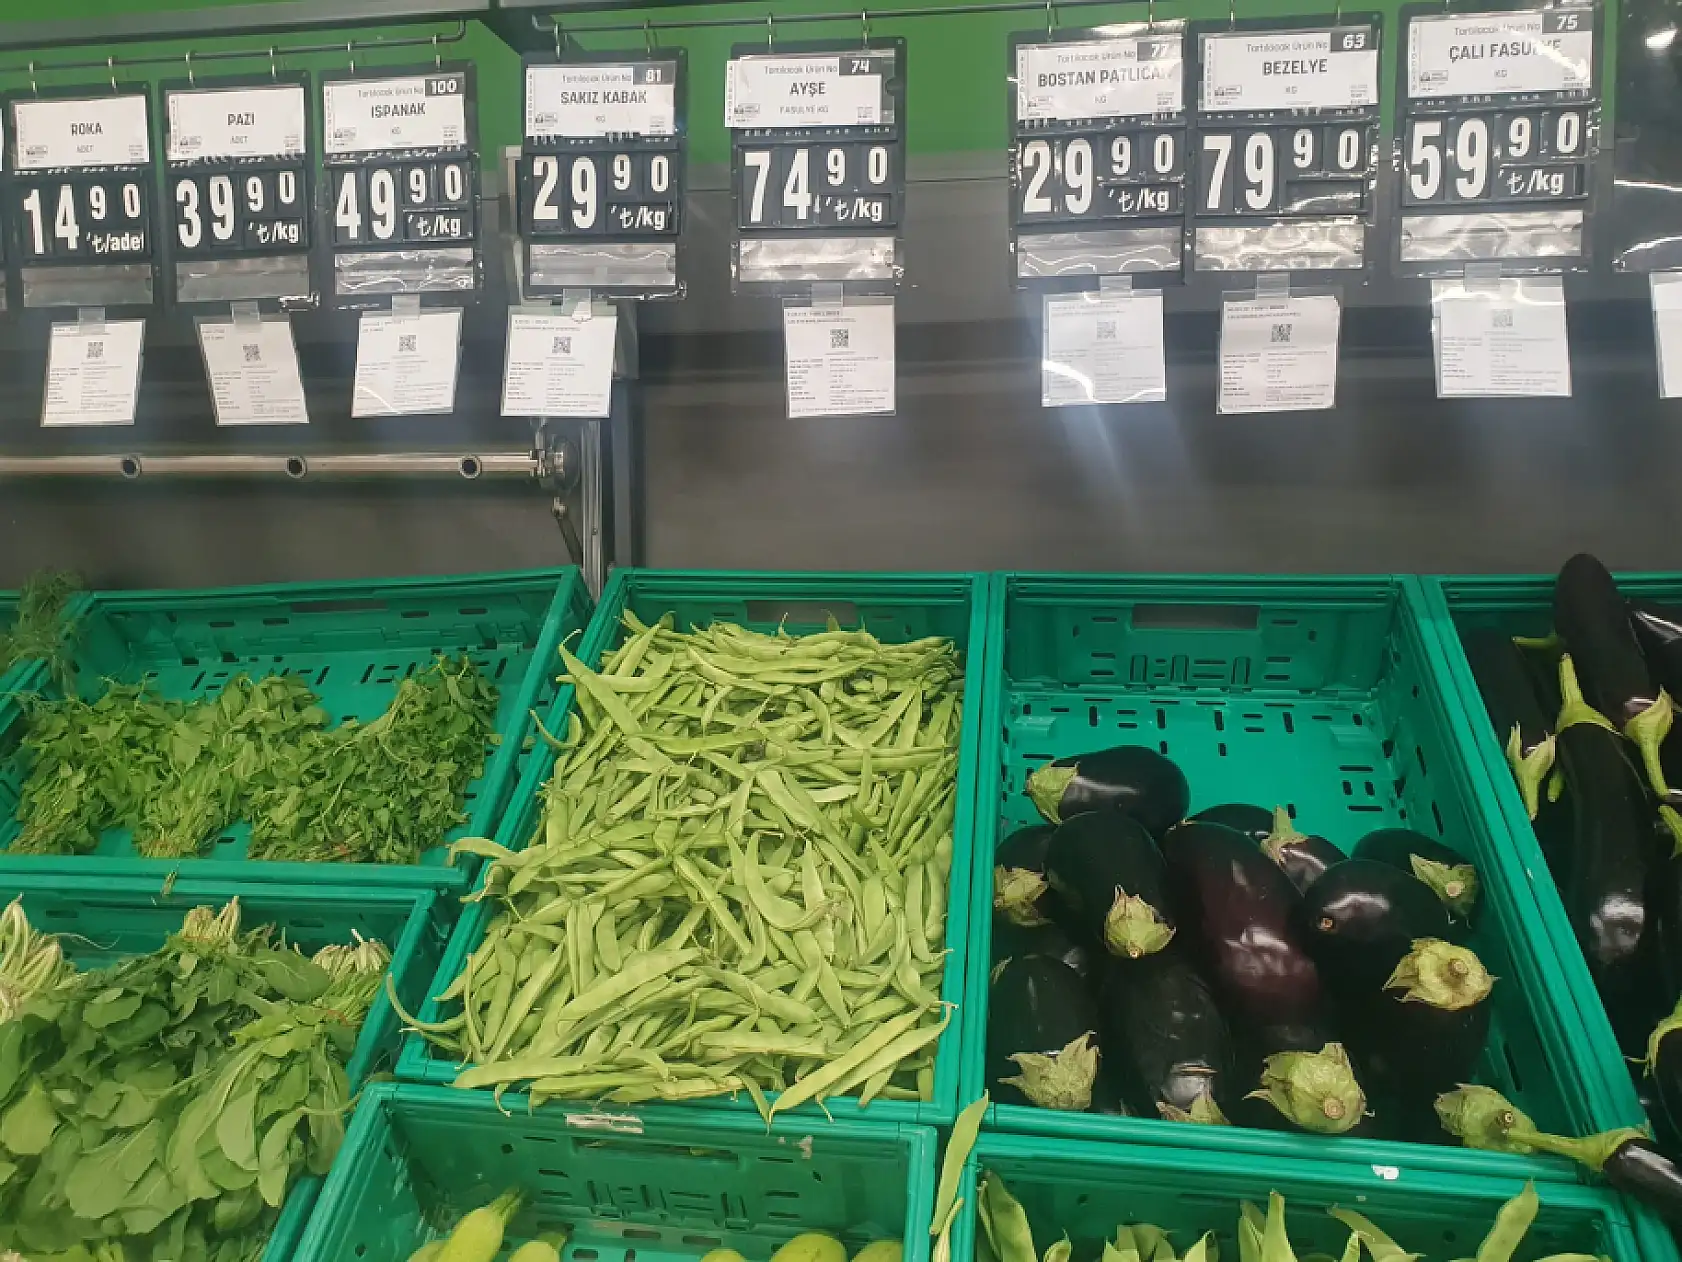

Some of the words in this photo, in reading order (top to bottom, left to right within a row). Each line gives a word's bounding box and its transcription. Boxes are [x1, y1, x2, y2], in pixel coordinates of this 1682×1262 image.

[1556, 14, 1579, 30] 75
[1448, 44, 1485, 64] ÇALI
[1490, 39, 1562, 58] FASUE
[851, 58, 870, 74] 74
[1263, 58, 1328, 76] BEZELYE
[430, 79, 457, 95] 100
[1038, 69, 1096, 87] BOSTAN
[560, 90, 599, 105] SAKIZ
[603, 90, 648, 104] KABAK
[789, 81, 827, 97] AYŞE
[371, 101, 426, 118] ISPANAK
[71, 122, 103, 137] ROKA
[1411, 118, 1487, 199] 59
[1509, 112, 1579, 157] 90
[1023, 138, 1093, 214] 29
[1112, 134, 1174, 175] 90
[1204, 132, 1273, 210] 79
[1294, 129, 1358, 169] 90
[534, 156, 596, 228] 29
[613, 155, 668, 192] 90
[745, 149, 812, 223] 74
[828, 147, 887, 186] 90
[177, 176, 234, 247] 39
[247, 171, 295, 212] 90
[337, 169, 394, 239] 49
[410, 165, 462, 203] 90
[24, 184, 79, 254] 14
[90, 184, 140, 219] 90
